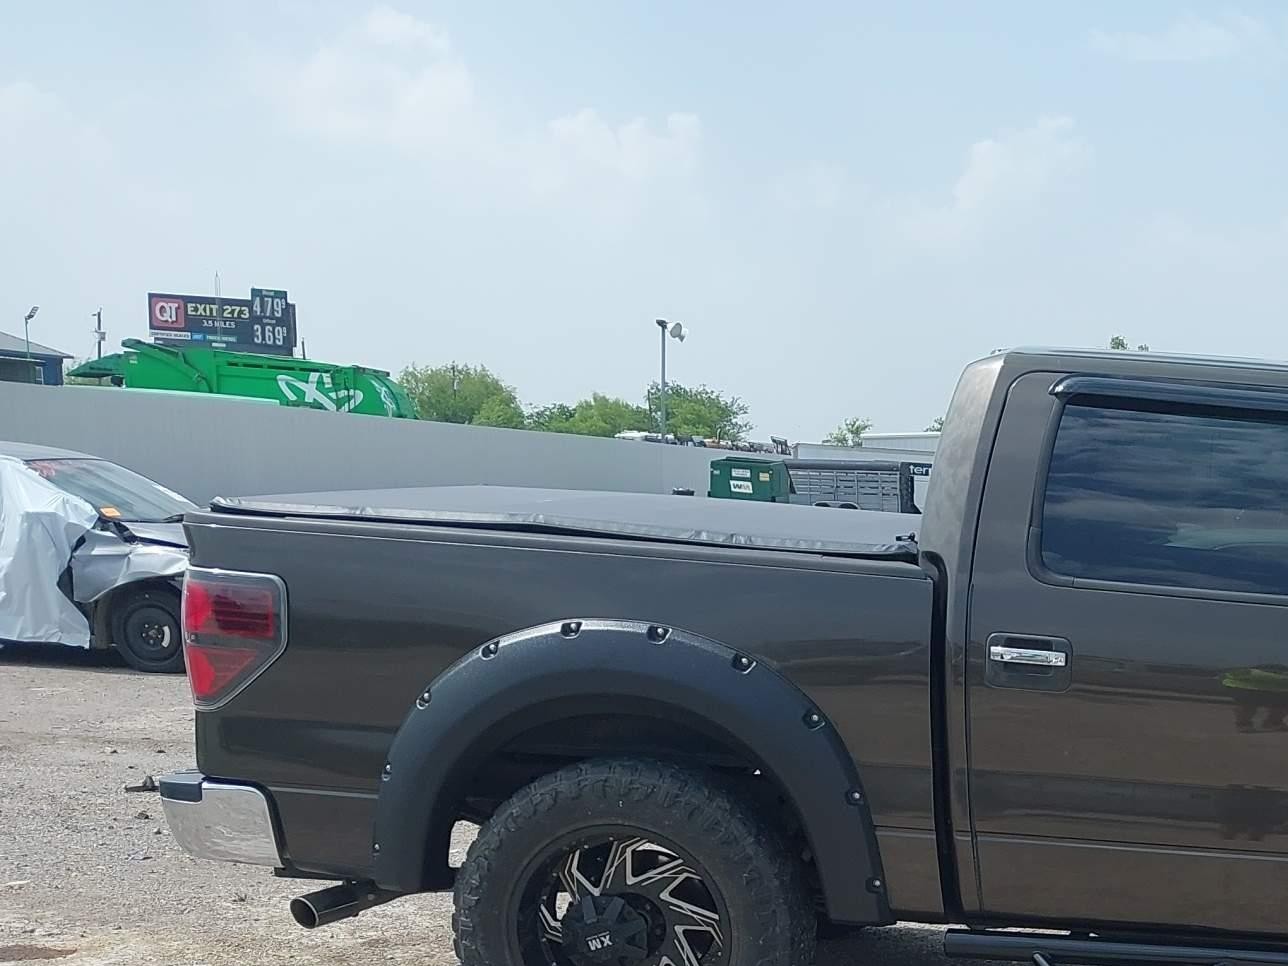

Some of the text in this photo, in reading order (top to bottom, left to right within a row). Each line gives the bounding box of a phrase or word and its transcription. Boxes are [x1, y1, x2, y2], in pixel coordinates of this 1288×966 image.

[155, 302, 178, 322] QT
[187, 303, 250, 319] EXIT 273
